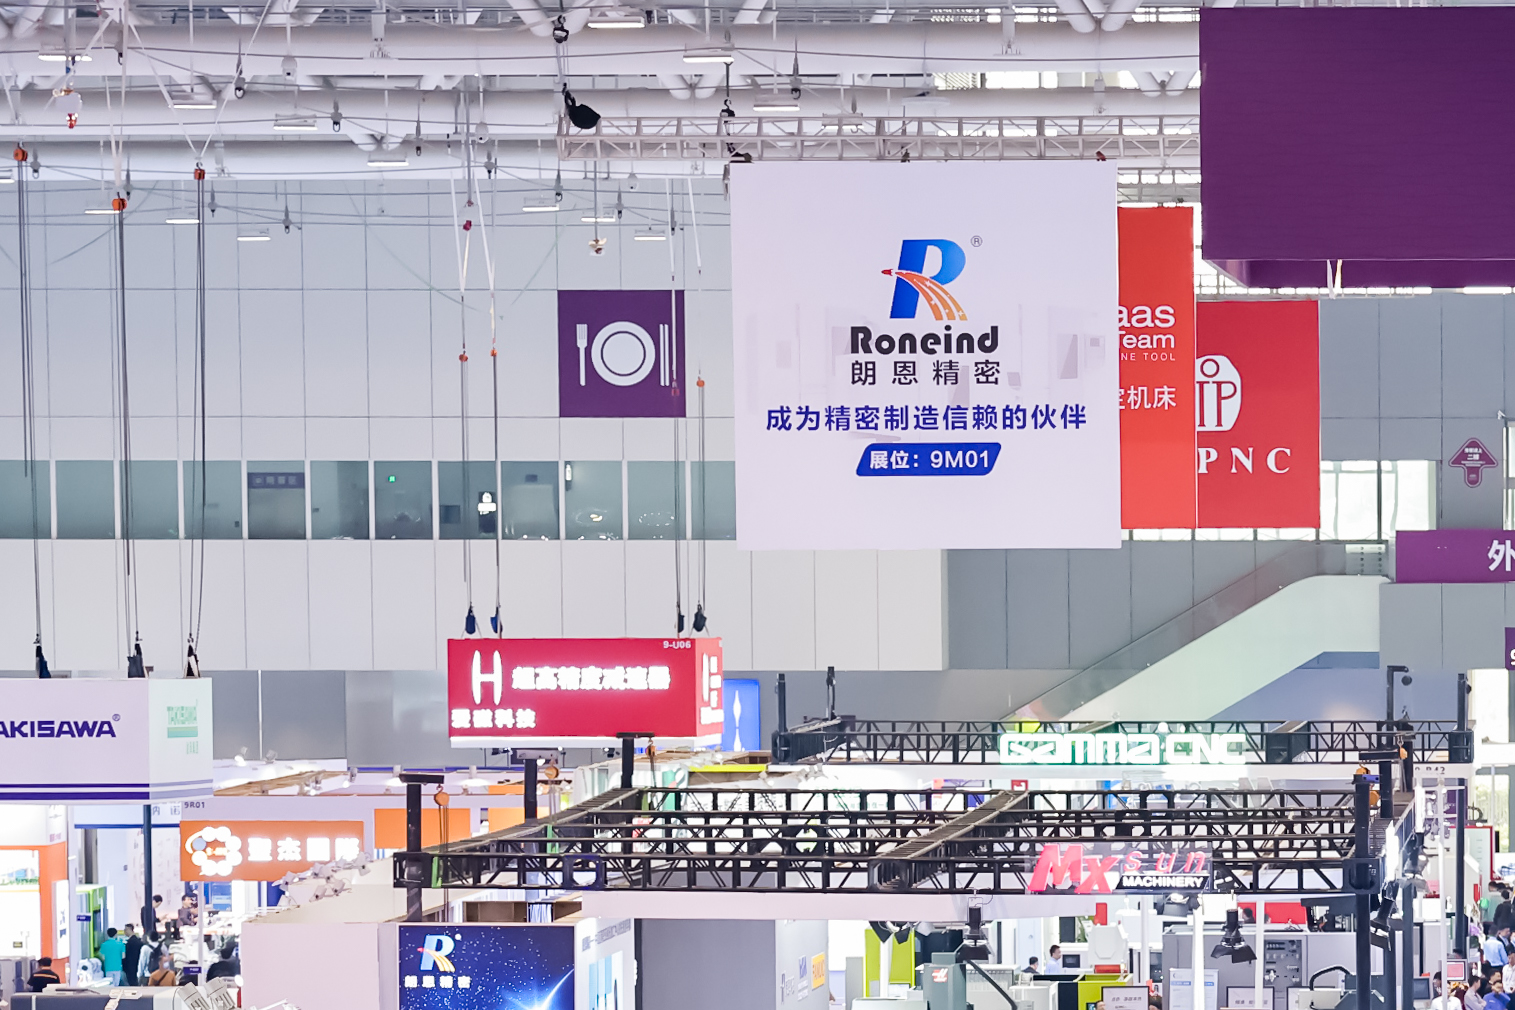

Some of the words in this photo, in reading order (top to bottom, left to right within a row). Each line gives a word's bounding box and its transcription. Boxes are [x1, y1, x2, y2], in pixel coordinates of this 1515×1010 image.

[1118, 305, 1175, 328] aas
[851, 325, 999, 355] Roneind
[1144, 352, 1175, 361] TOOL
[851, 360, 1001, 386] 朗恩精密
[766, 405, 1087, 432] 成为精密制造信赖的伙伴
[663, 641, 691, 649] 9-U06
[1166, 733, 1246, 764] CNC
[1122, 875, 1204, 888] MACHINERY
